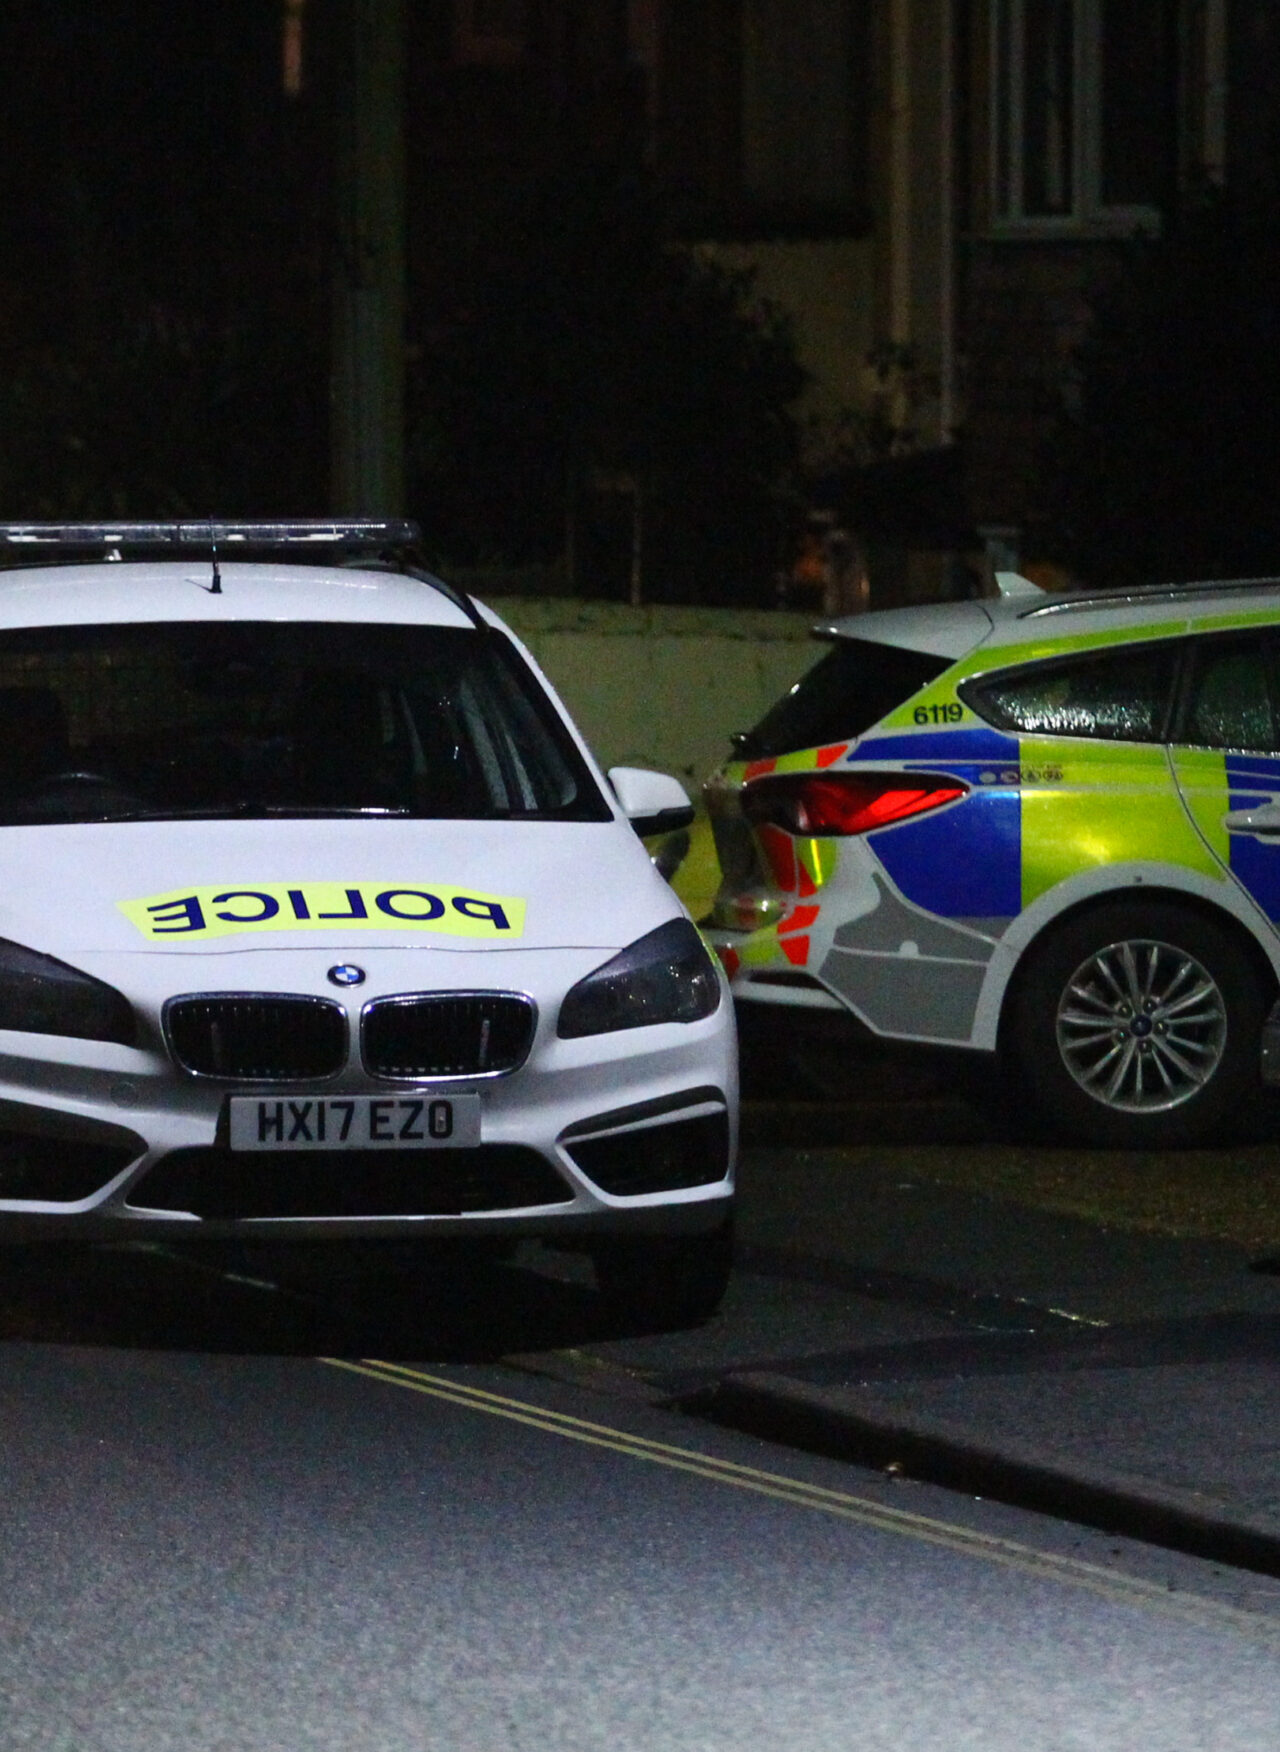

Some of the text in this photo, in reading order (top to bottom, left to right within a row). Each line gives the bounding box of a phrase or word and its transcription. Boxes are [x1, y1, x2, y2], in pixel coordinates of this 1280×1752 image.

[914, 702, 963, 725] 6119
[258, 1100, 454, 1143] HX17 EZO
